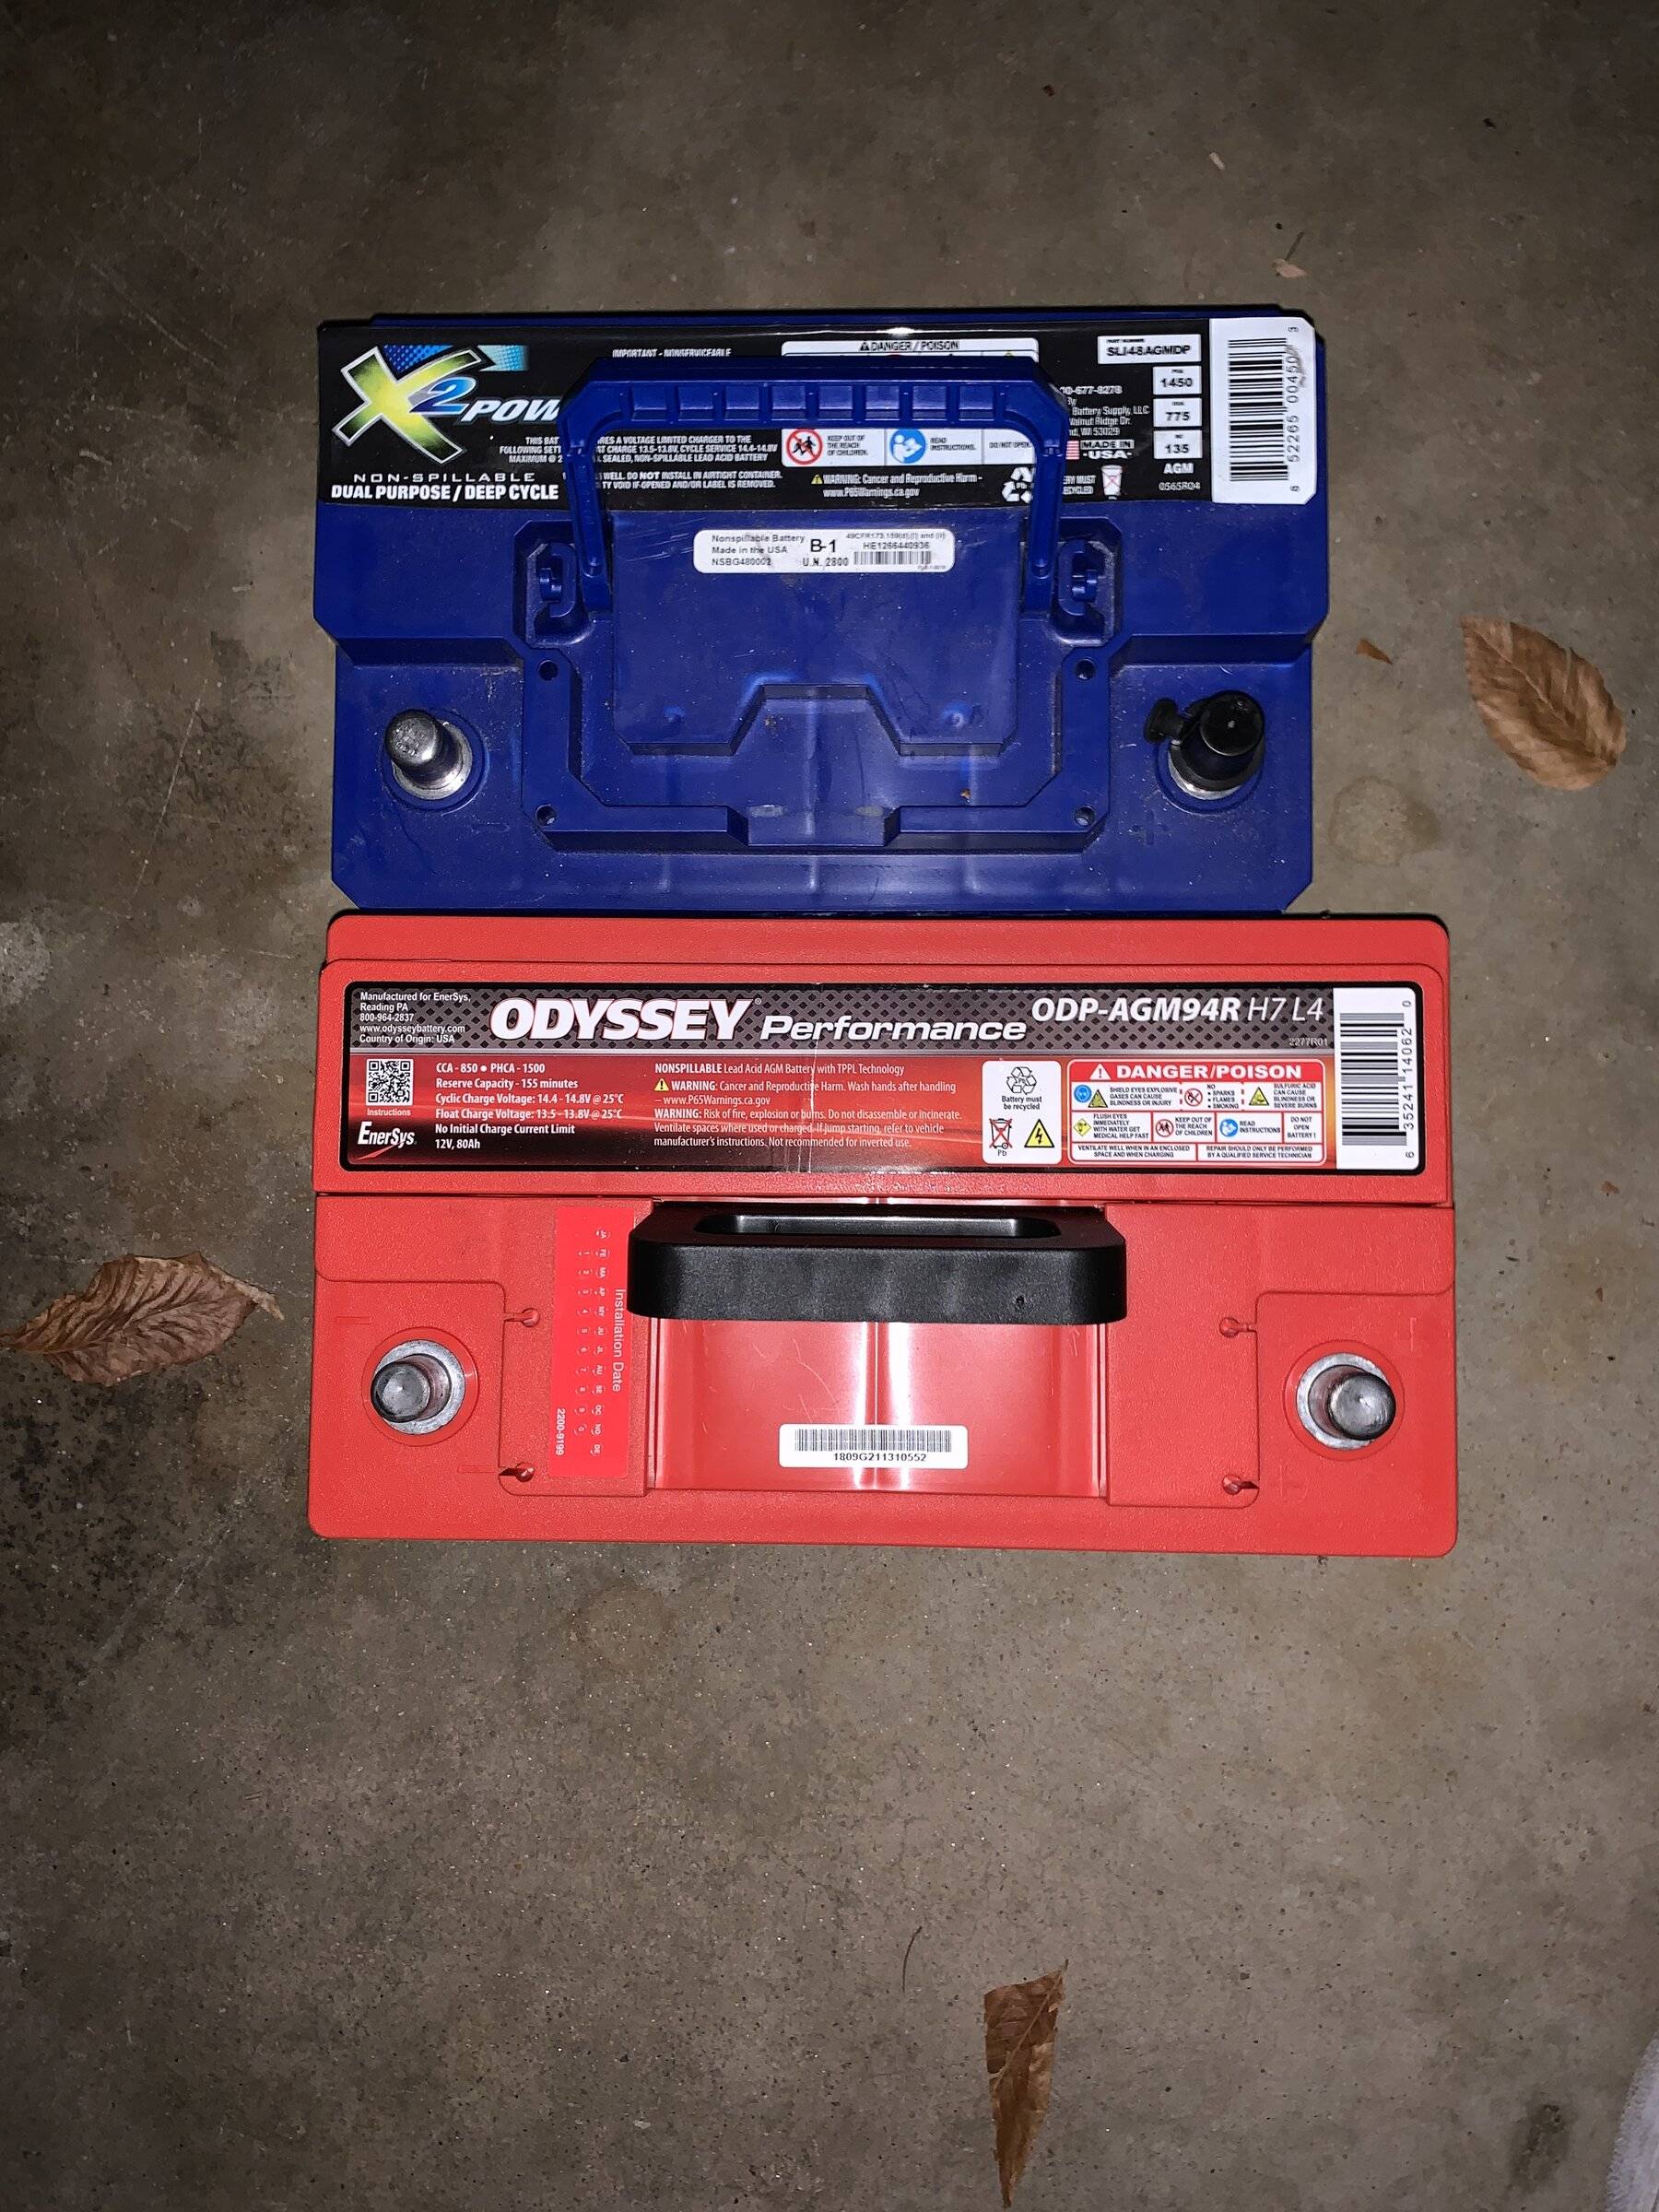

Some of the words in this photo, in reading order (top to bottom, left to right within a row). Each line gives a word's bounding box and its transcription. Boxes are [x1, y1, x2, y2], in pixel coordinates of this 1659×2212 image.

[871, 341, 912, 350] DANGER
[922, 341, 959, 350] POISON
[1161, 378, 1193, 387] 1450
[1166, 412, 1190, 420] 775
[1082, 441, 1116, 449] MADE
[1119, 440, 1131, 448] IN
[1165, 444, 1189, 453] 135
[1163, 464, 1194, 474] AGM
[354, 473, 535, 483] NON-SPILLABLE
[331, 485, 374, 500] DUAL
[376, 485, 450, 500] PURPOSE
[465, 486, 506, 500] DEEP
[509, 486, 559, 500] CYCLE
[712, 546, 735, 554] Made
[739, 546, 747, 554] in
[749, 546, 765, 554] the
[768, 546, 787, 554] USA
[811, 539, 836, 553] B-1
[360, 992, 418, 1001] Manufactured
[419, 992, 431, 1000] for
[360, 1003, 394, 1012] Reading
[397, 1003, 408, 1011] PA
[1031, 997, 1239, 1021] ODP-AGM94R
[1248, 997, 1286, 1021] H7
[1292, 997, 1324, 1021] L4
[360, 1013, 414, 1021] 800-964-2837
[359, 1025, 465, 1033] www.odysseybattery.com
[759, 1015, 1027, 1041] Performance
[359, 1035, 393, 1044] Country
[406, 1035, 433, 1044] Origin:
[1402, 1029, 1413, 1074] 14062
[436, 1063, 453, 1073] CCA
[461, 1064, 477, 1073] 850
[490, 1064, 515, 1073] PHCA
[524, 1064, 545, 1073] 1500
[655, 1064, 723, 1074] NONSPILLABLE
[724, 1064, 743, 1074] Lead
[746, 1064, 762, 1074] Acid
[764, 1064, 782, 1074] AGM
[785, 1064, 815, 1076] Battery
[818, 1064, 835, 1074] with
[838, 1065, 856, 1074] TPPL
[859, 1064, 904, 1077] Technology
[1117, 1065, 1301, 1079] DANGER/POISON
[436, 1078, 473, 1088] Reserve
[475, 1078, 513, 1090] Capacity
[522, 1079, 537, 1088] 155
[540, 1078, 578, 1088] minutes
[672, 1081, 718, 1091] WARNING:
[720, 1081, 746, 1091] Cancer
[748, 1081, 763, 1091] and
[821, 1082, 845, 1091] Harm.
[848, 1081, 869, 1091] Wash
[872, 1081, 896, 1091] hands
[898, 1081, 918, 1091] after
[920, 1081, 956, 1093] handling
[436, 1094, 461, 1104] Cyclic
[463, 1094, 495, 1105] Charge
[497, 1094, 535, 1105] Voltage:
[537, 1094, 558, 1103] 14.4
[565, 1094, 591, 1103] 14.8V
[664, 1095, 771, 1107] www.P65Warnings.ca.gov
[368, 1108, 411, 1116] Instructions
[1013, 1102, 1040, 1111] recycled
[1403, 1085, 1414, 1130] 35241
[436, 1109, 459, 1119] Float
[461, 1109, 494, 1120] Charge
[496, 1109, 534, 1120] Voltage:
[536, 1110, 556, 1119] 13.5
[564, 1110, 589, 1119] 13.8V
[654, 1109, 701, 1118] WARNING:
[704, 1109, 720, 1118] Risk
[722, 1109, 731, 1118] of
[733, 1109, 747, 1120] fire,
[749, 1110, 788, 1122] explosion
[829, 1110, 839, 1119] Do
[841, 1111, 855, 1119] not
[857, 1109, 906, 1119] disassemble
[919, 1110, 961, 1120] incinerate.
[358, 1121, 415, 1148] EnerSys
[436, 1124, 448, 1134] No
[450, 1124, 477, 1134] Initial
[480, 1124, 512, 1135] Charge
[514, 1124, 548, 1134] Current
[551, 1124, 575, 1134] Limit
[654, 1123, 690, 1133] Ventilate
[692, 1124, 719, 1135] spaces
[721, 1123, 747, 1133] where
[748, 1123, 766, 1133] used
[817, 1124, 824, 1133] If
[824, 1124, 844, 1135] jump
[884, 1124, 903, 1134] refer
[905, 1125, 913, 1134] to
[915, 1124, 944, 1134] vehicle
[436, 1139, 454, 1149] 12V,
[457, 1139, 480, 1148] 80Ah
[717, 1137, 766, 1147] instructions.
[769, 1137, 782, 1147] Not
[785, 1137, 843, 1147] recommended
[846, 1137, 857, 1147] for
[859, 1138, 893, 1147] inverted
[614, 1289, 627, 1358] Installation
[612, 1362, 624, 1392] Date
[556, 1408, 566, 1455] 2200-9199
[834, 1453, 926, 1462] 1809G211310552
